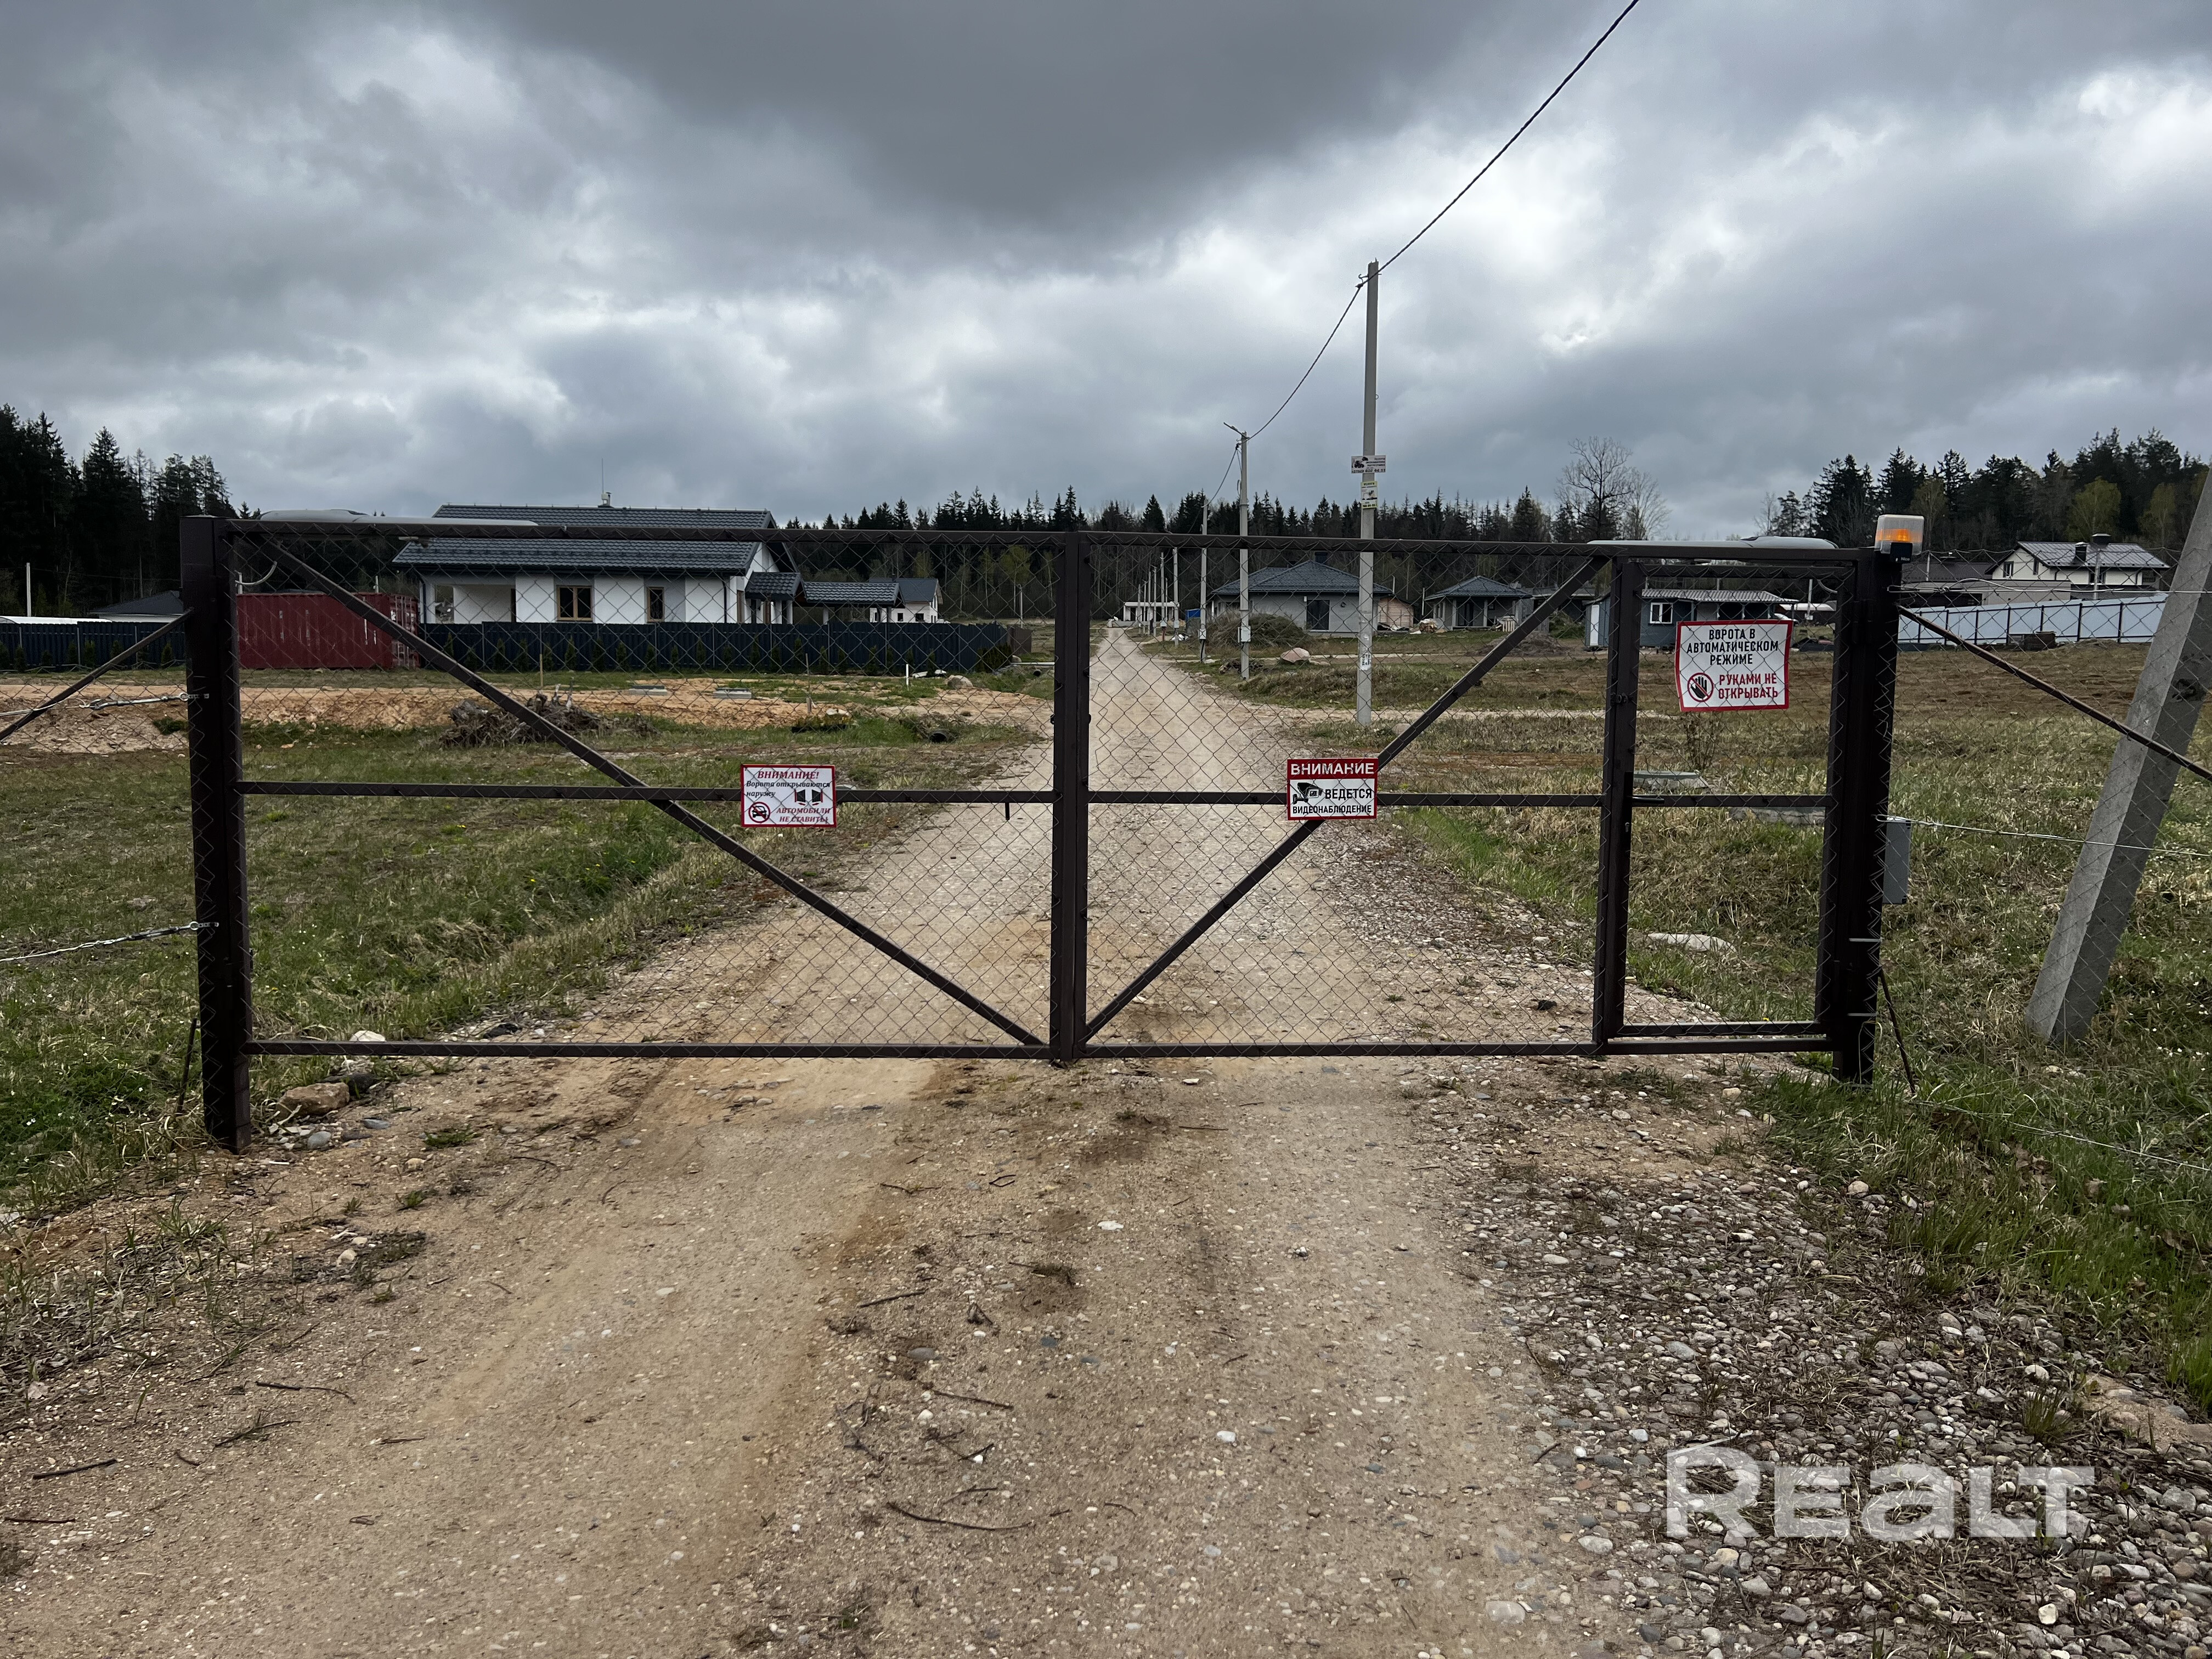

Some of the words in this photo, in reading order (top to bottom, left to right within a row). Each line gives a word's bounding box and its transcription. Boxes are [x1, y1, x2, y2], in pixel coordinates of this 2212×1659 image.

[1709, 629, 1746, 640] ВОРОТА
[1750, 629, 1755, 639] В
[1686, 641, 1779, 653] АВТОМАТИЧЕСКОМ
[1710, 654, 1753, 665] РЕЖИМЕ
[1719, 674, 1761, 685] РУКАМИ
[1765, 673, 1777, 684] НЕ
[1718, 687, 1778, 699] ОТКРЫВАТЬ
[1291, 763, 1374, 775] ВНИМАНИЕ
[758, 771, 819, 779] ВНИМАНИЕ!
[1325, 789, 1372, 800] ВЕДЕТСЯ
[1293, 805, 1372, 815] ВИДЕОНАБЛЮДЕНИЕ
